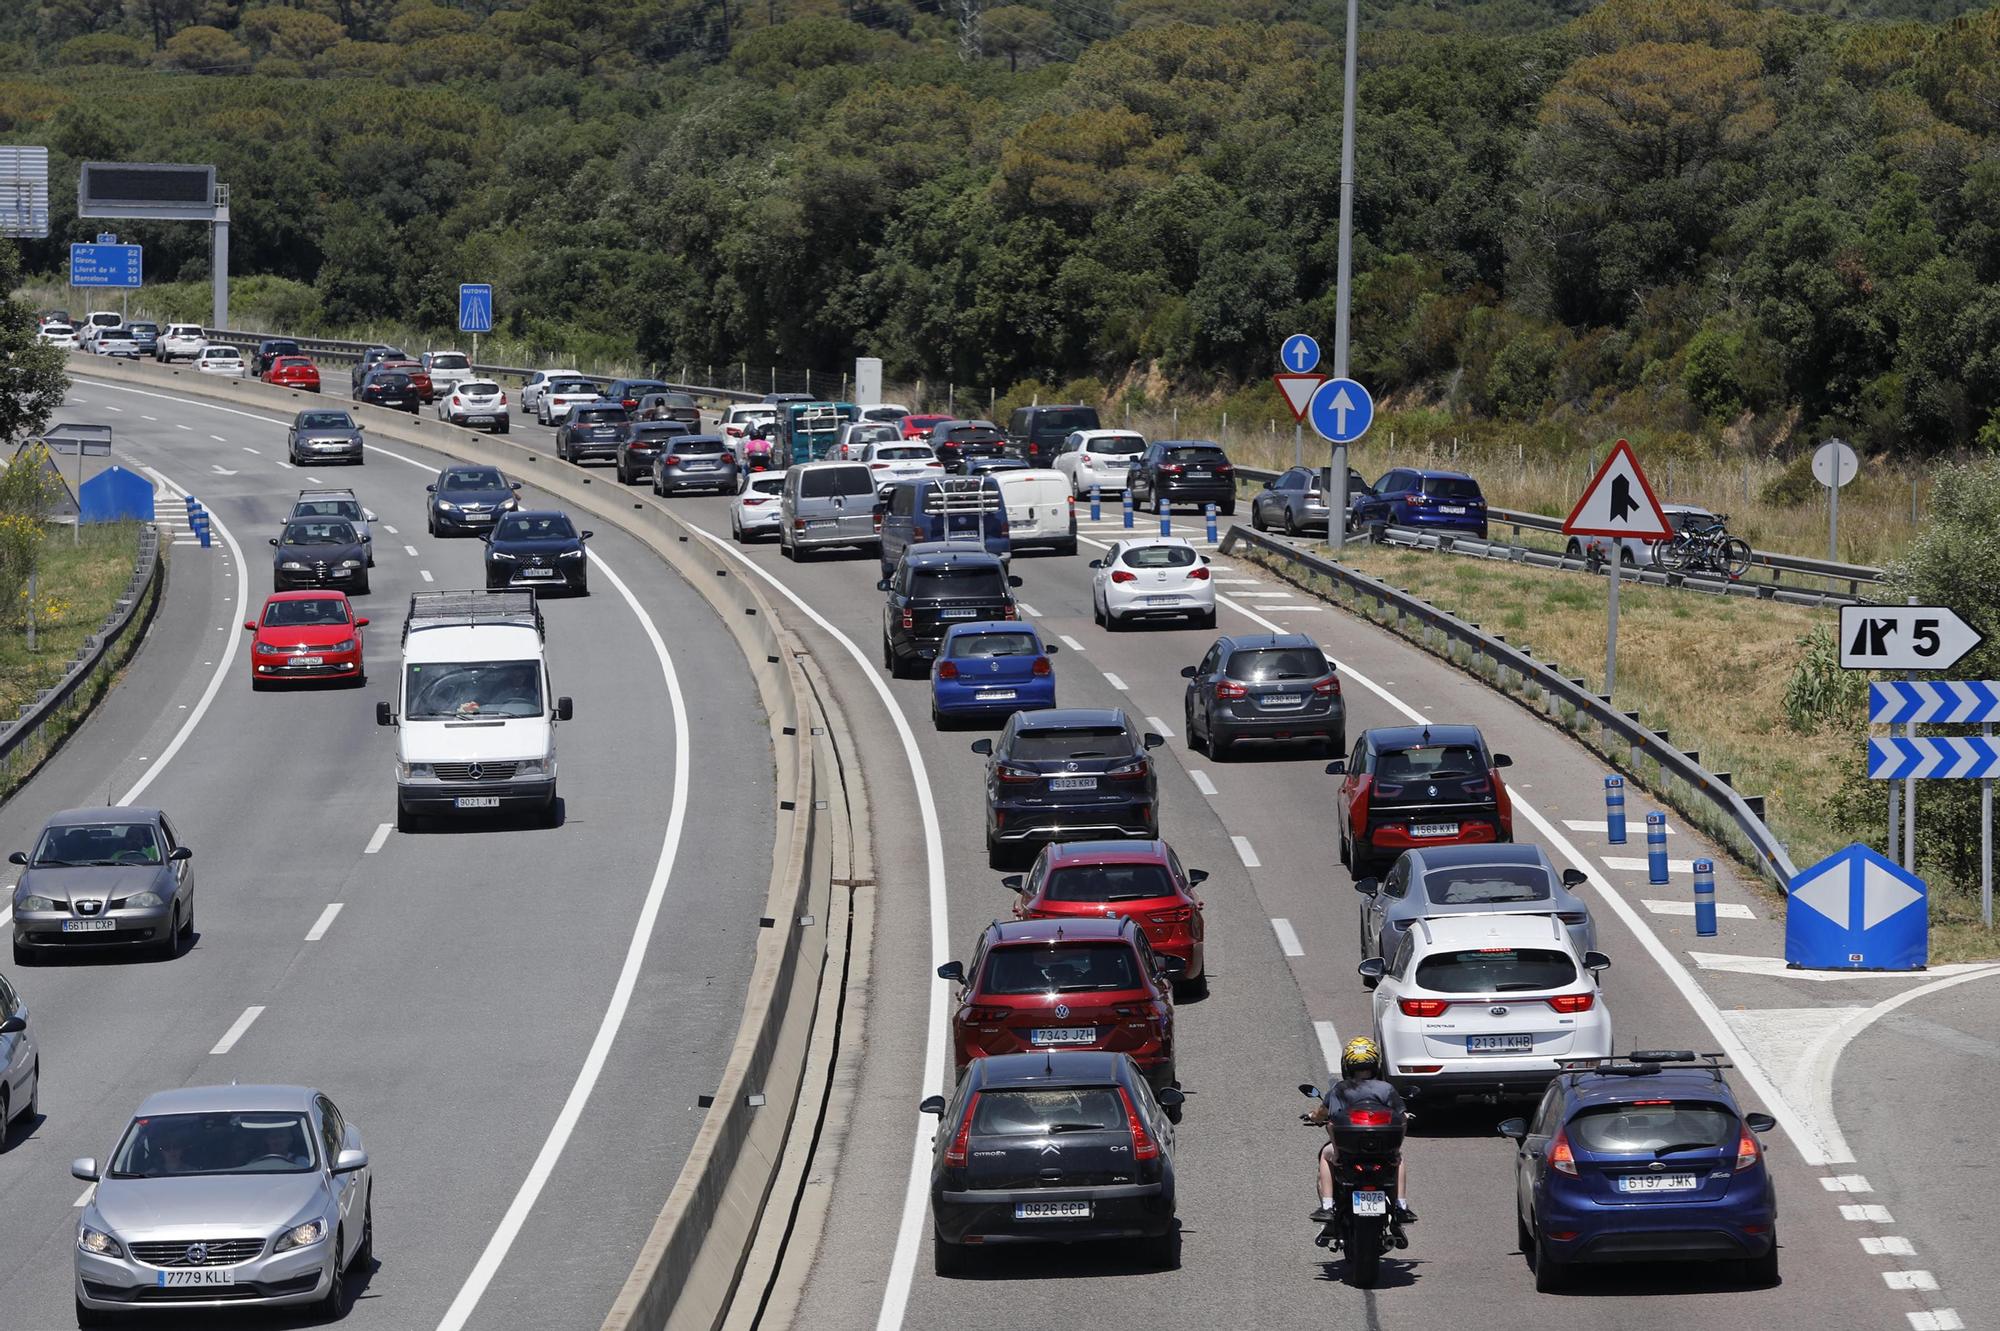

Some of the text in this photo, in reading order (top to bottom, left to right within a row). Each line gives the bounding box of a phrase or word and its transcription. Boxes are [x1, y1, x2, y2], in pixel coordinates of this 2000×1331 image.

[1912, 620, 1940, 656] 5
[1055, 780, 1076, 788] 5123
[460, 798, 480, 806] 9021
[1417, 824, 1456, 833] 1568 KXT
[68, 920, 112, 930] 6611 CXP
[1039, 1030, 1094, 1040] 7343 JZH
[1474, 1036, 1531, 1048] 2131 KHB
[1629, 1174, 1692, 1188] 6197 JMK
[1025, 1203, 1086, 1216] 0826 GCP
[1361, 1202, 1378, 1212] LXC
[168, 1270, 230, 1284] 7779 KLL
